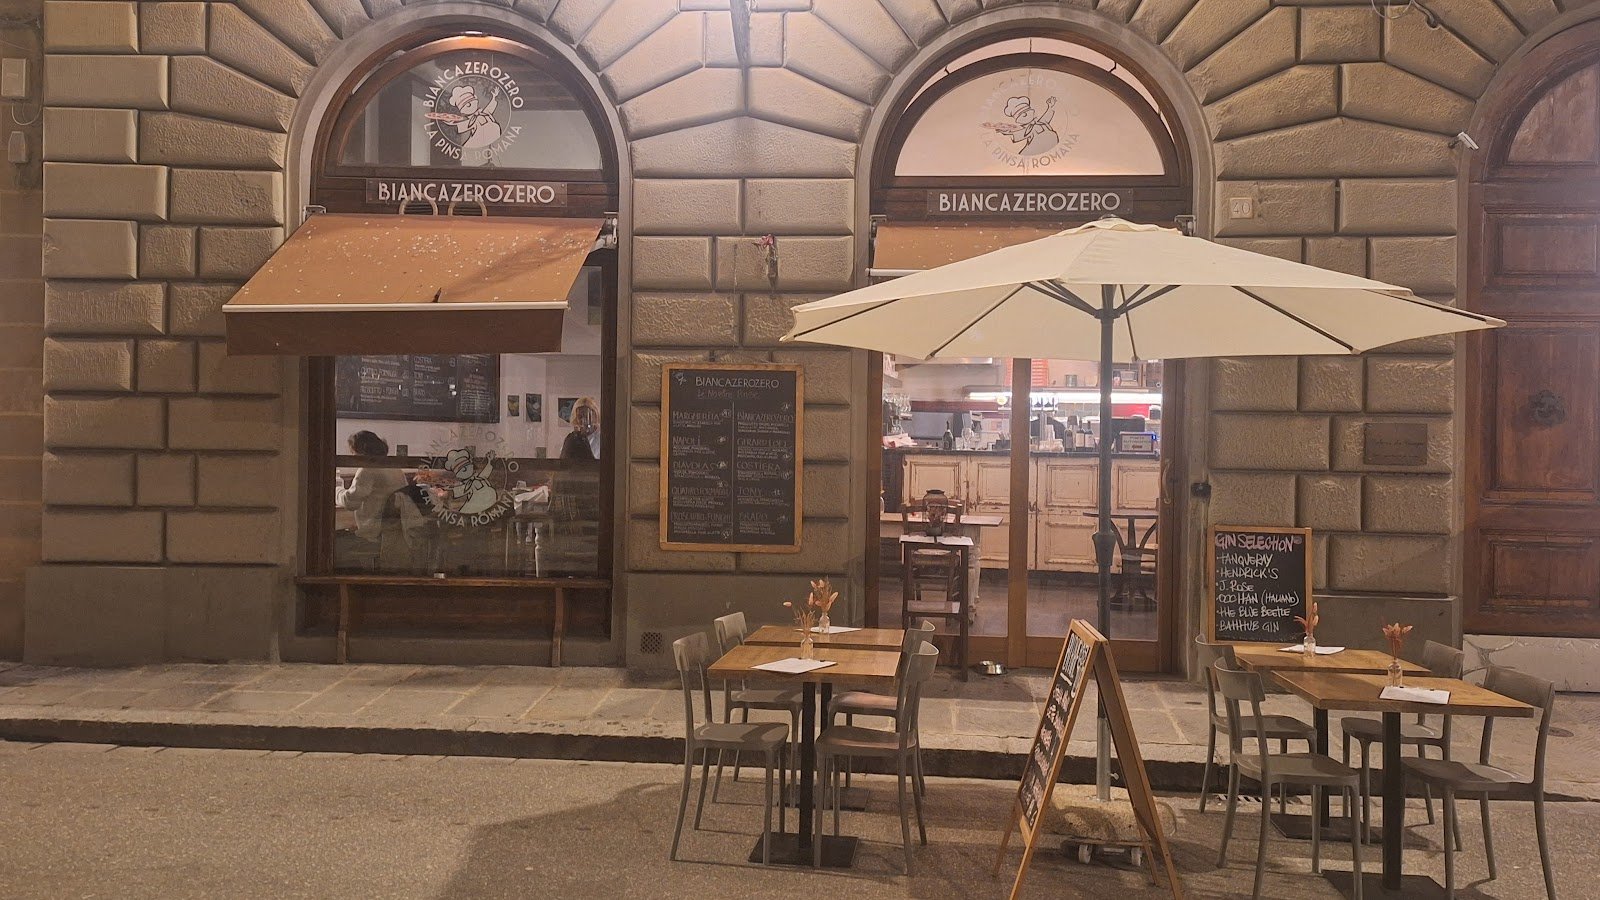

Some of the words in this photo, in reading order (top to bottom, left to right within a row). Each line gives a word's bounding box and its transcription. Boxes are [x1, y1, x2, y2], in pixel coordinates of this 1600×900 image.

[423, 61, 524, 109] BIANCAZEROZERO
[423, 121, 438, 140] LA
[435, 138, 468, 161] PINSA
[991, 147, 1026, 169] PINSA
[1032, 133, 1080, 169] ROMANA
[378, 182, 556, 204] BIANCAZEROZERO
[939, 192, 1121, 212] BIANCAZEROZERO
[1232, 201, 1251, 215] 40
[695, 376, 780, 389] BIANCAZEROZERO
[737, 461, 781, 471] COSTIERA
[471, 489, 517, 528] ROMANA
[1215, 533, 1237, 550] GIN
[1237, 534, 1294, 553] SELECTION
[1220, 553, 1273, 567] TANQUERAY
[1220, 567, 1279, 579] HENDRICK'S
[1219, 607, 1236, 618] THE
[1238, 606, 1259, 617] BLUE
[1261, 606, 1291, 618] BEETLE
[1262, 621, 1280, 633] GIN
